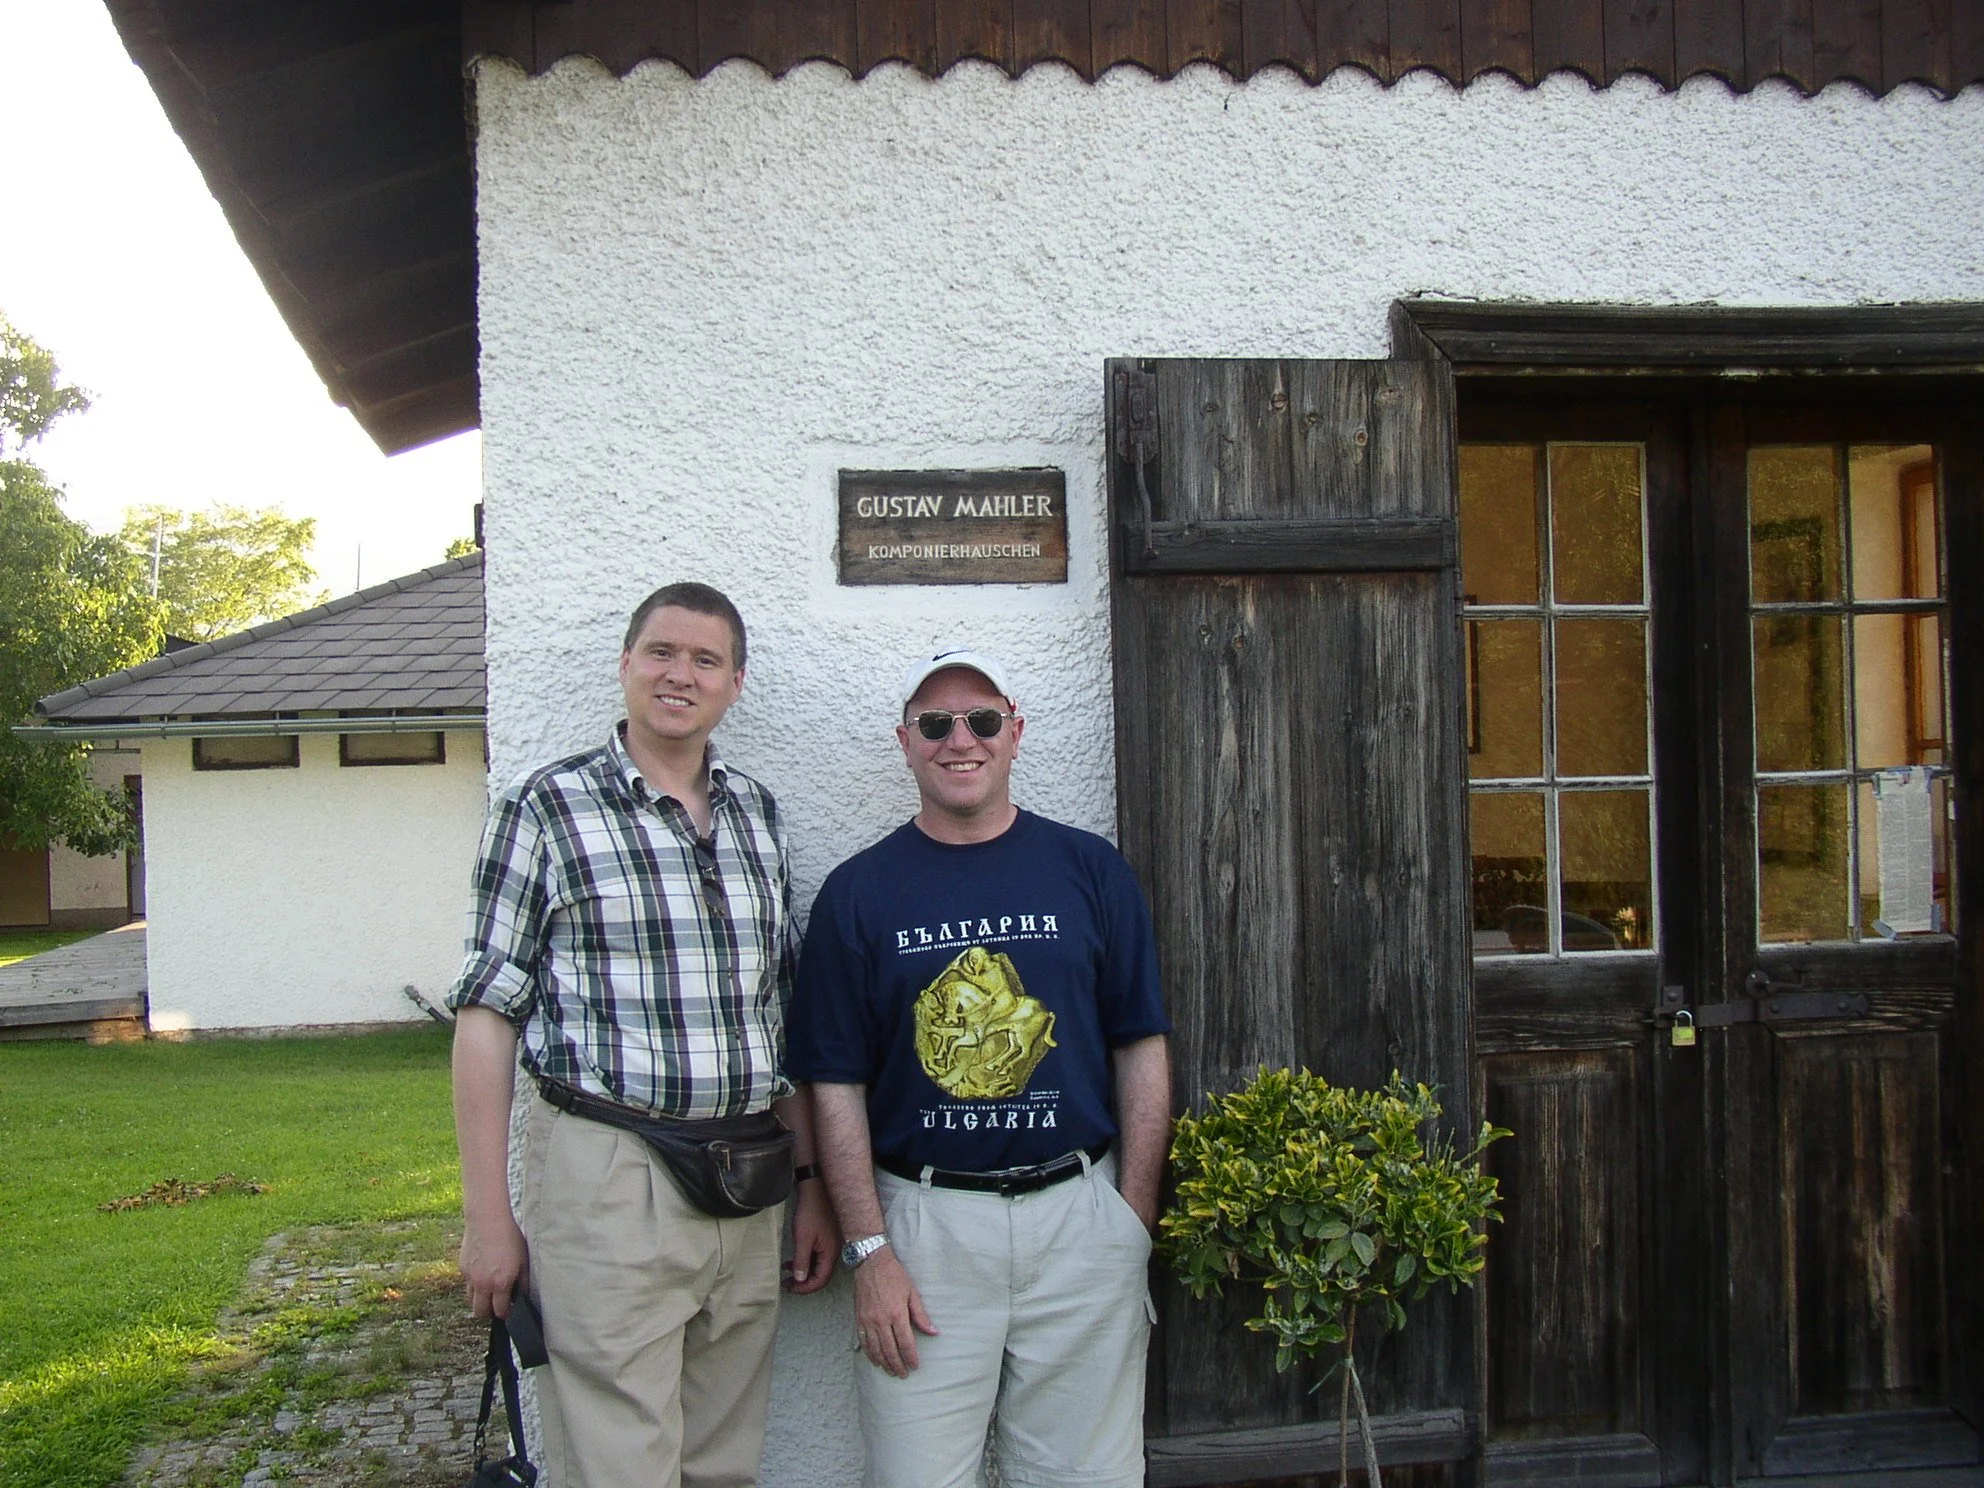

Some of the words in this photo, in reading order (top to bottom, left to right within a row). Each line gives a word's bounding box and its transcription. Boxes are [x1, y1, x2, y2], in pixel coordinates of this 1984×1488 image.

[857, 495, 943, 518] GUSTAV
[953, 495, 1053, 518] MAHLER
[896, 914, 1059, 948] БЪЛГАРИЯ
